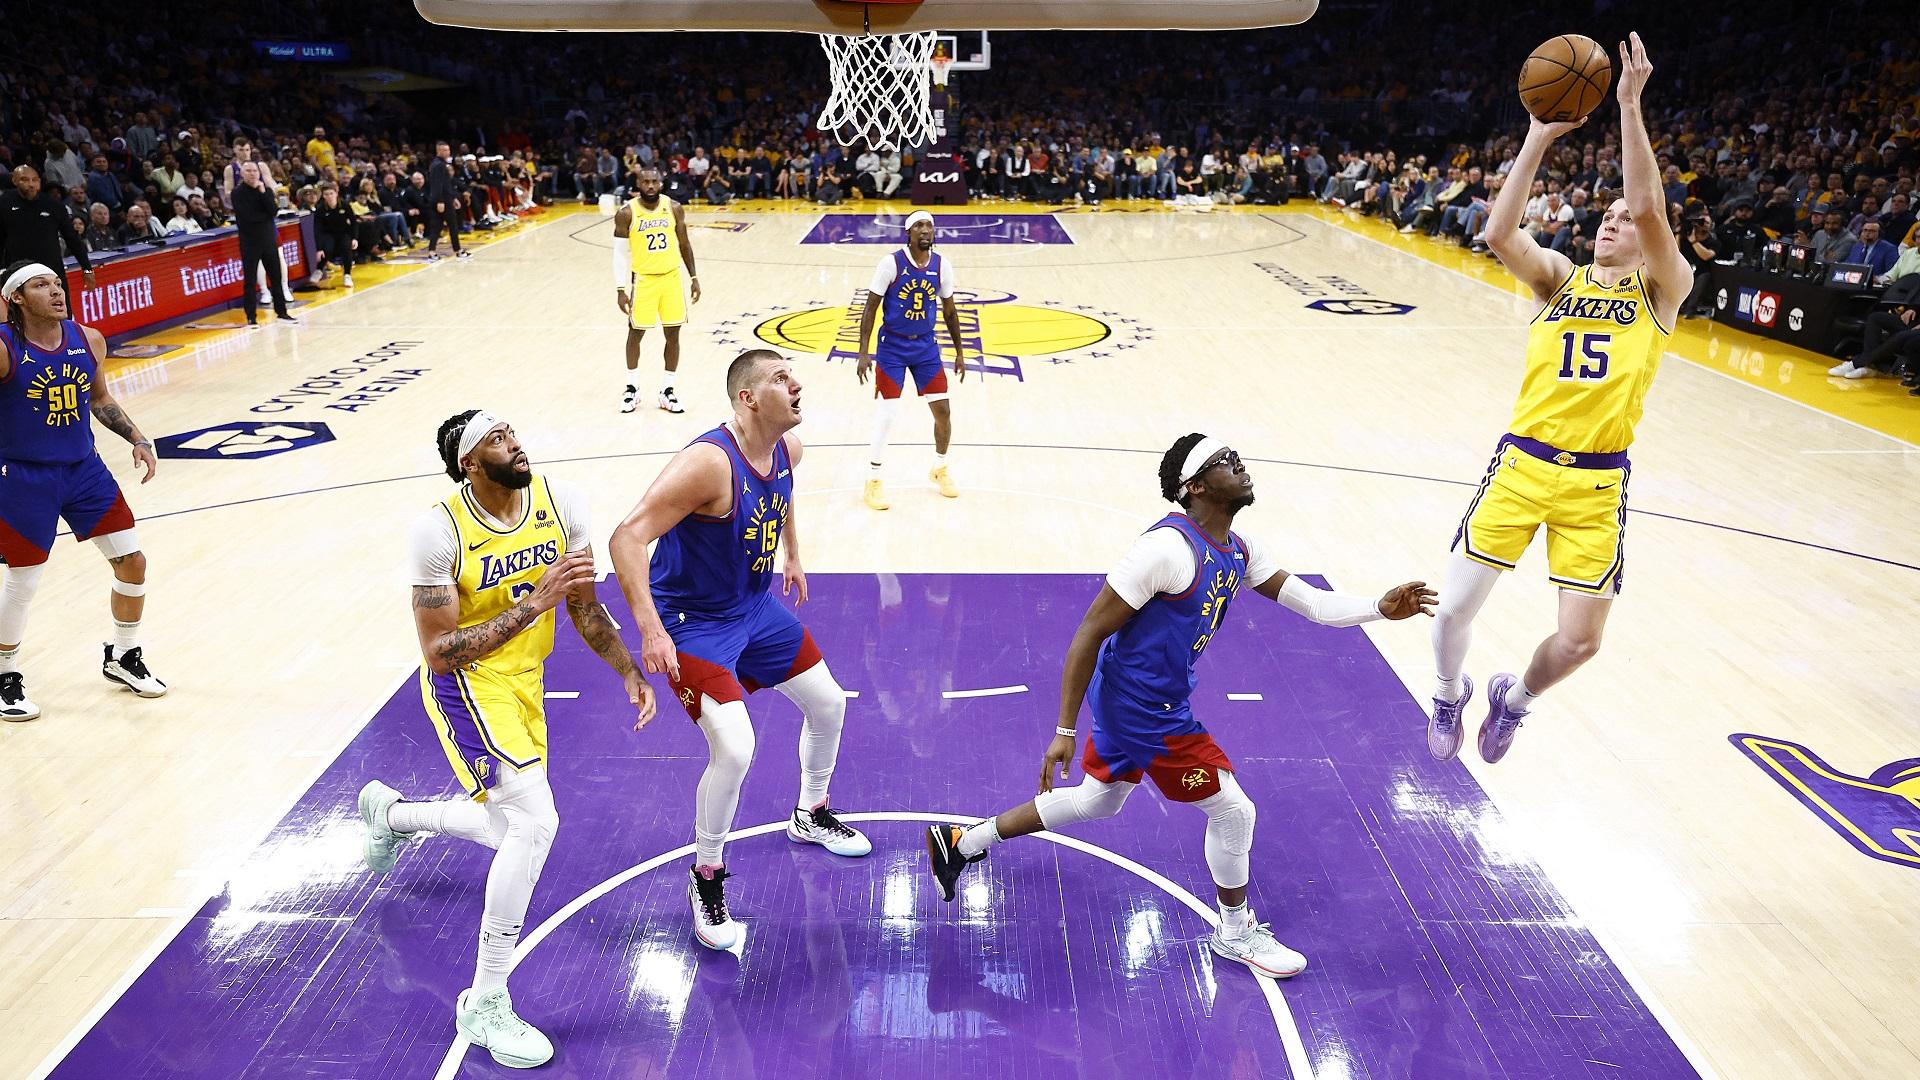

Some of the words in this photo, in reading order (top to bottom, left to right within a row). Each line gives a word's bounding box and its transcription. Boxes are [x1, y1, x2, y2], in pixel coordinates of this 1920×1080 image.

[302, 47, 334, 57] ULTRA
[919, 172, 959, 183] KIA
[637, 219, 669, 232] LAKERS
[646, 233, 667, 251] 23
[81, 285, 104, 323] FLY
[108, 276, 154, 317] BETTER
[179, 259, 244, 297] Emirate
[898, 278, 918, 300] MILE
[920, 279, 936, 301] HIGH
[913, 292, 923, 310] 5
[1614, 284, 1638, 293] bibigo
[904, 309, 926, 321] CITY
[1544, 293, 1638, 325] LAKERS
[1558, 331, 1611, 379] 15
[27, 365, 57, 400] MILE
[62, 363, 91, 393] HIGH
[250, 341, 425, 413] crypto.com
[322, 368, 432, 412] ARENA
[48, 383, 77, 412] 50
[46, 408, 80, 427] CITY
[534, 520, 555, 529] bibigo
[744, 496, 767, 540] MILE
[761, 519, 777, 553] 15
[476, 539, 559, 591] LAKERS
[1201, 569, 1224, 616] MILE
